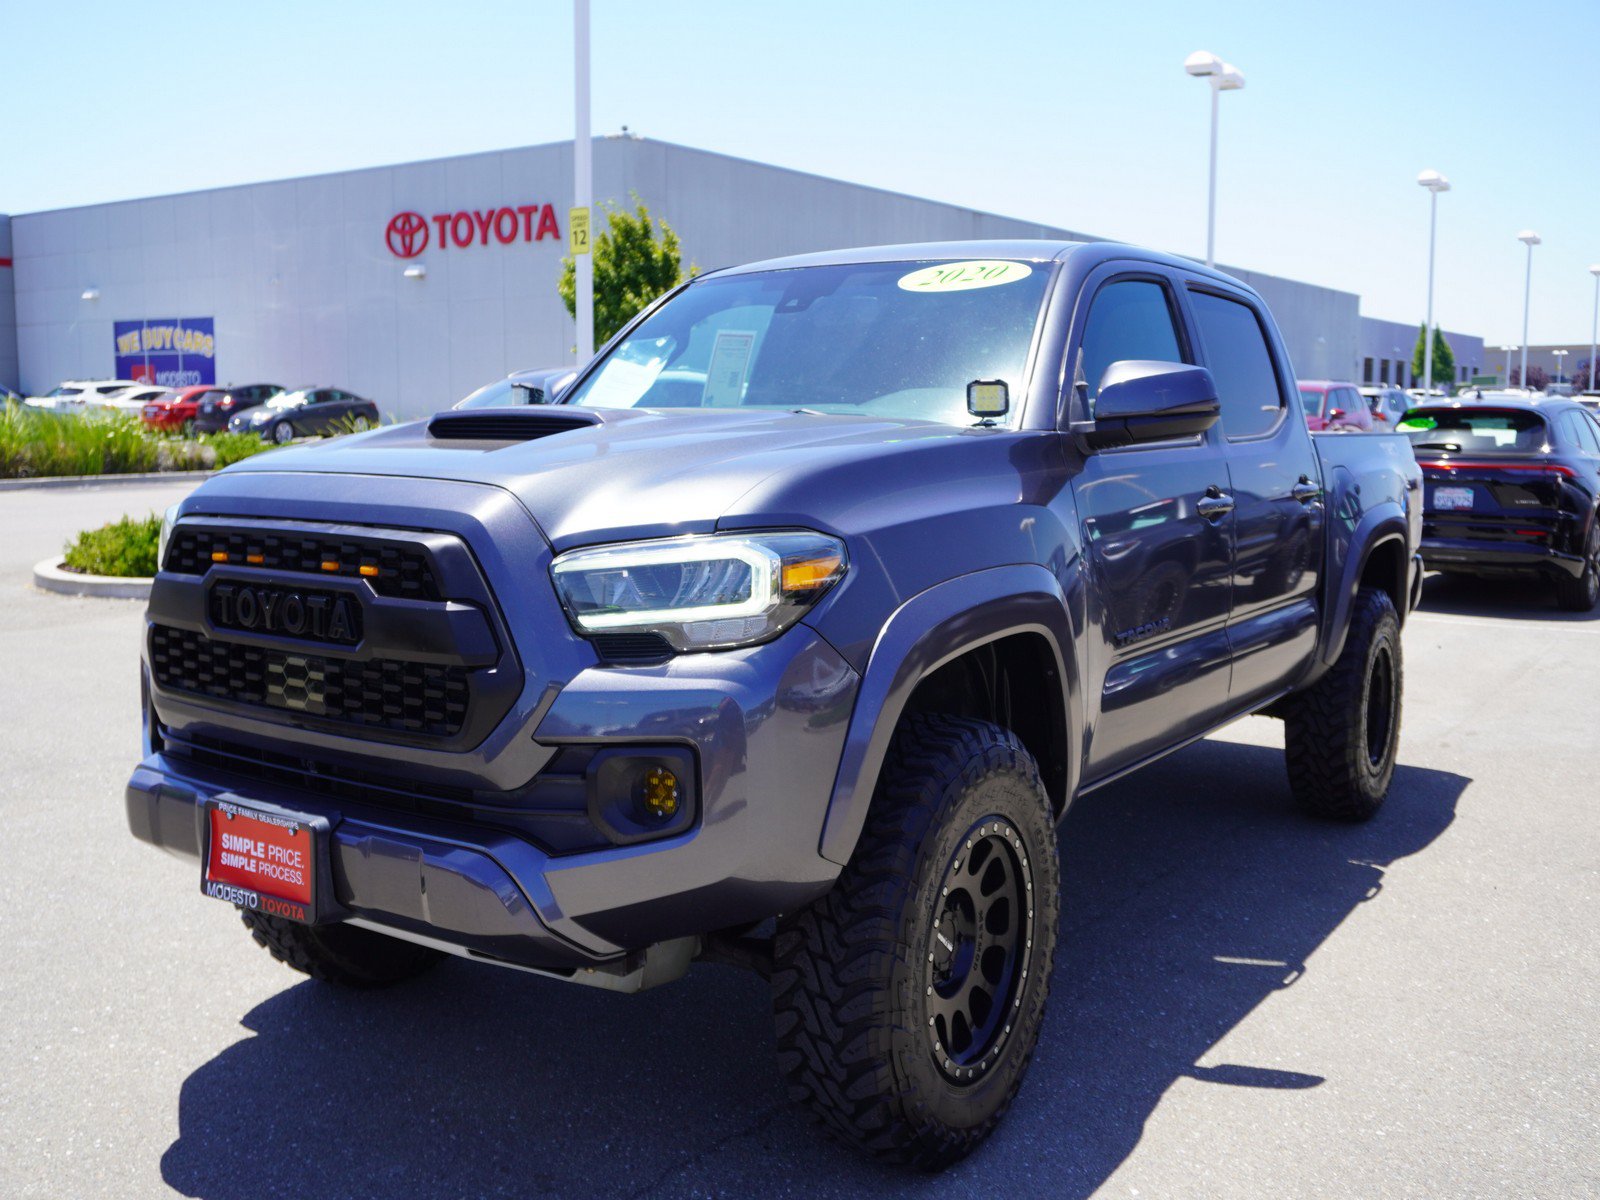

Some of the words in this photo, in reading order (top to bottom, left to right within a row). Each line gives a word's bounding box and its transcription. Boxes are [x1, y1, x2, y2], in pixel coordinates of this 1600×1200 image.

[432, 203, 561, 249] TOYOTA
[573, 230, 587, 246] 12
[913, 265, 1009, 286] 2020
[117, 330, 140, 357] WE
[141, 326, 174, 350] BUY
[173, 327, 213, 358] CARS
[216, 585, 357, 640] TOYOTA
[1115, 617, 1172, 647] TACOMA
[218, 802, 238, 815] PRICE
[238, 807, 258, 820] FAMILY
[221, 833, 265, 858] SIMPLE
[268, 845, 304, 869] PRICE.
[220, 852, 256, 873] SIMPLE
[258, 862, 305, 886] PROCESS.
[206, 881, 258, 908] MODESTO
[261, 896, 305, 921] TOYOTA
